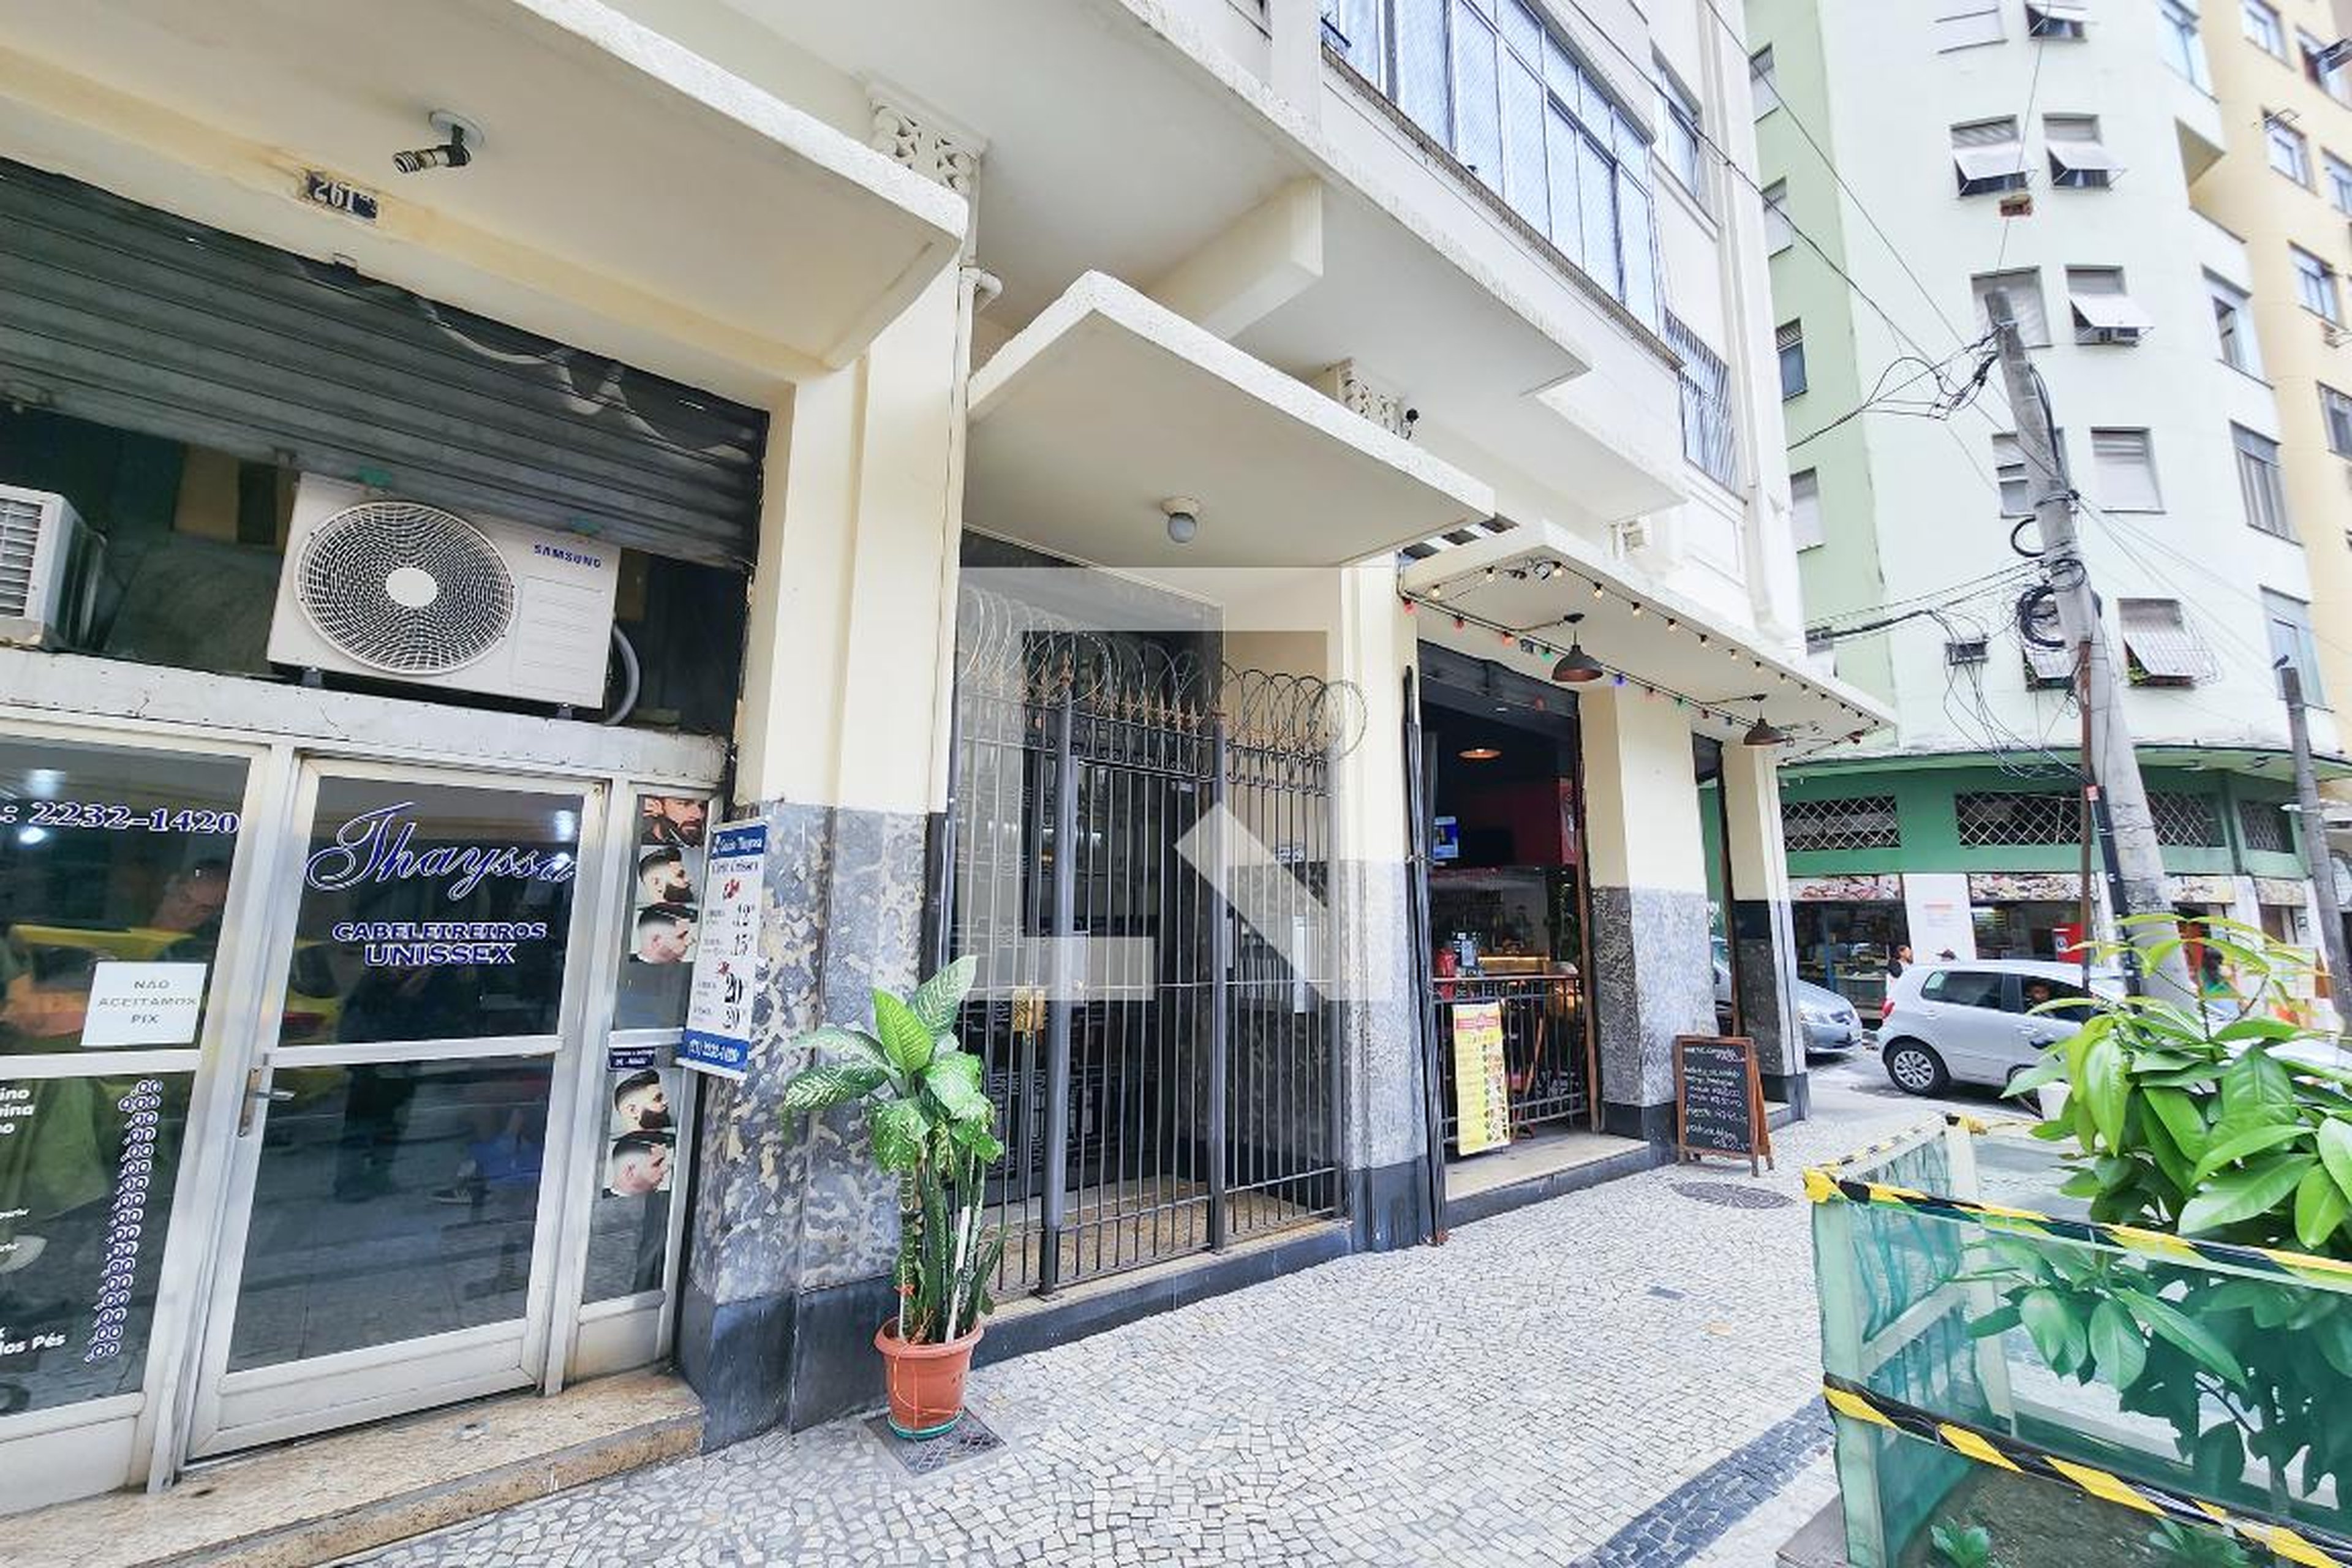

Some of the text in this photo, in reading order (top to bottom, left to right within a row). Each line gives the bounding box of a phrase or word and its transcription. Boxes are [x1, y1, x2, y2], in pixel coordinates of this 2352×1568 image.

[533, 544, 601, 568] SAMSUNG
[28, 802, 240, 834] 2232-1420
[305, 802, 576, 901] Thayssa
[332, 922, 547, 942] CABELEIREIROS
[364, 943, 517, 967] UNISSEX
[130, 1014, 160, 1024] PIX
